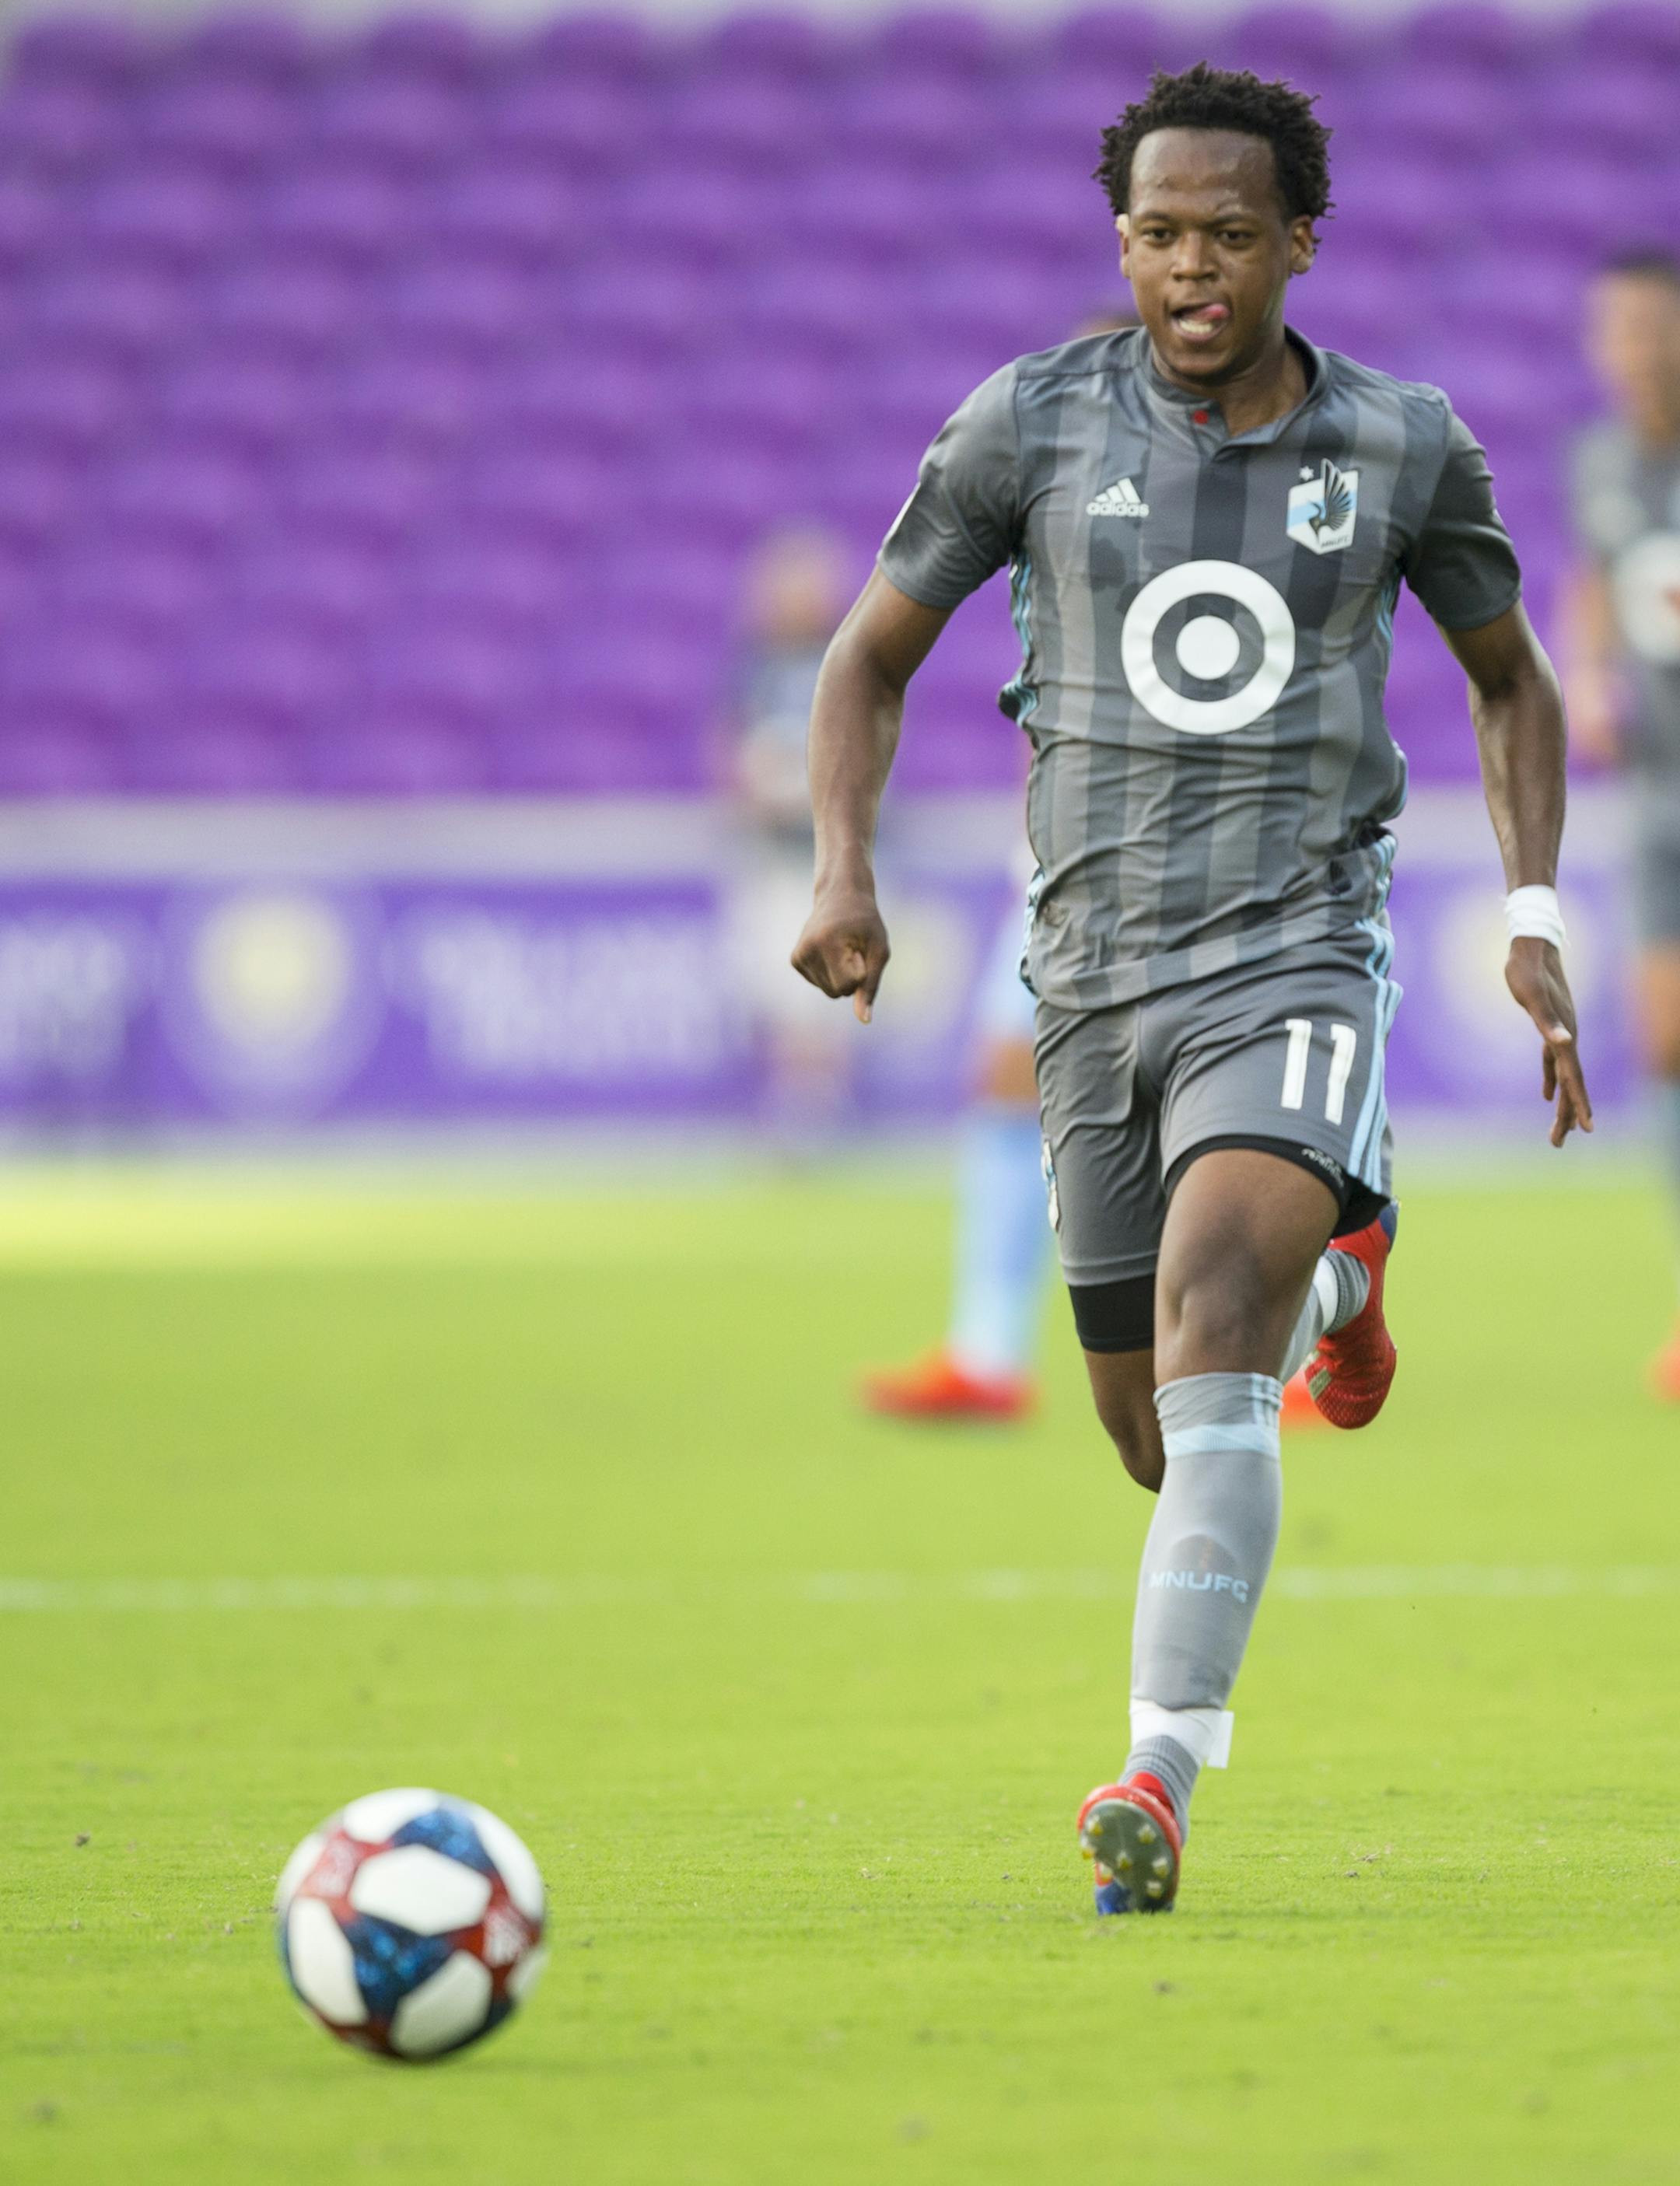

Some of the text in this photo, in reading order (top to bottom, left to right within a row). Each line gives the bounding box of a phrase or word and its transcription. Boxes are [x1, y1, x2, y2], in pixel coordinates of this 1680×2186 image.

[1086, 500, 1150, 518] adidas
[1280, 1018, 1356, 1126] 11
[1147, 1569, 1250, 1604] MNUFC
